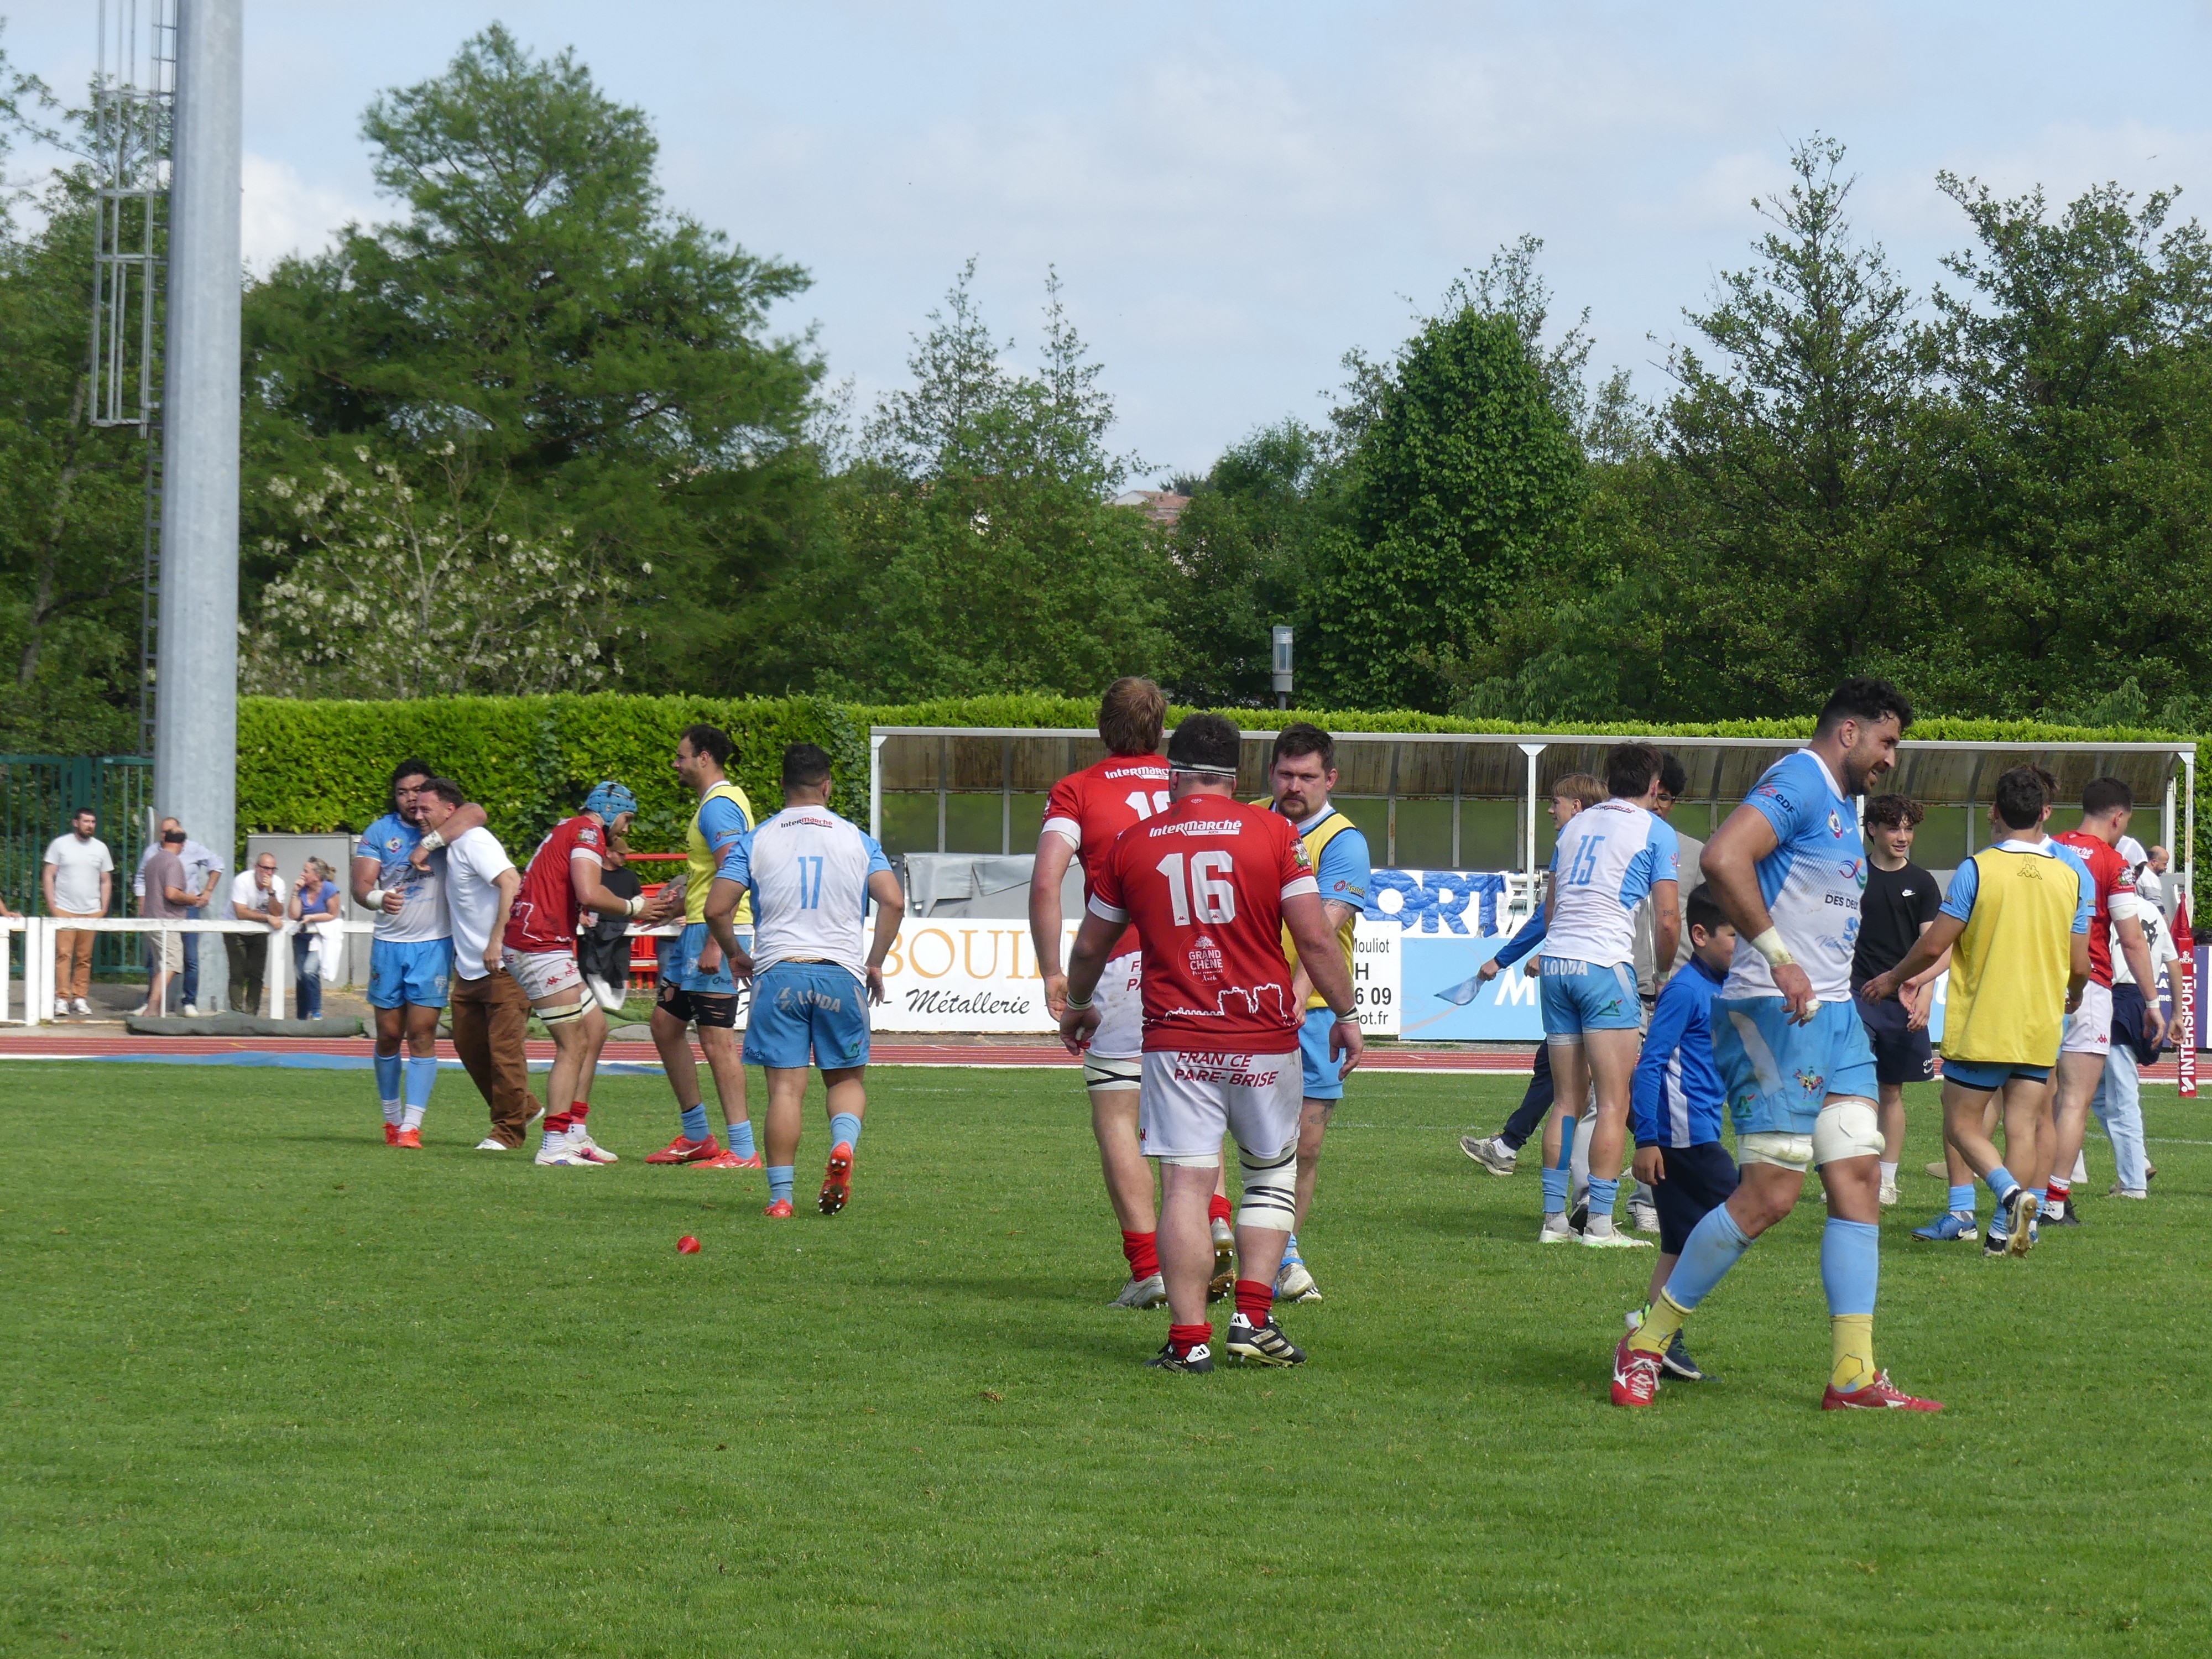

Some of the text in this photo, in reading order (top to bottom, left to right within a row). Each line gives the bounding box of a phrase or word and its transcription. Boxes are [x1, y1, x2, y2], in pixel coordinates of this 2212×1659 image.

[1149, 819, 1242, 838] Intermarché
[1568, 834, 1606, 885] 15
[797, 856, 823, 910] 17
[1155, 850, 1236, 927] 16
[1824, 894, 1844, 907] DES
[1188, 950, 1221, 960] GRAND
[1544, 959, 1588, 976] LOUDA
[905, 988, 1030, 1014] Métallerie
[1370, 987, 1392, 1006] 09
